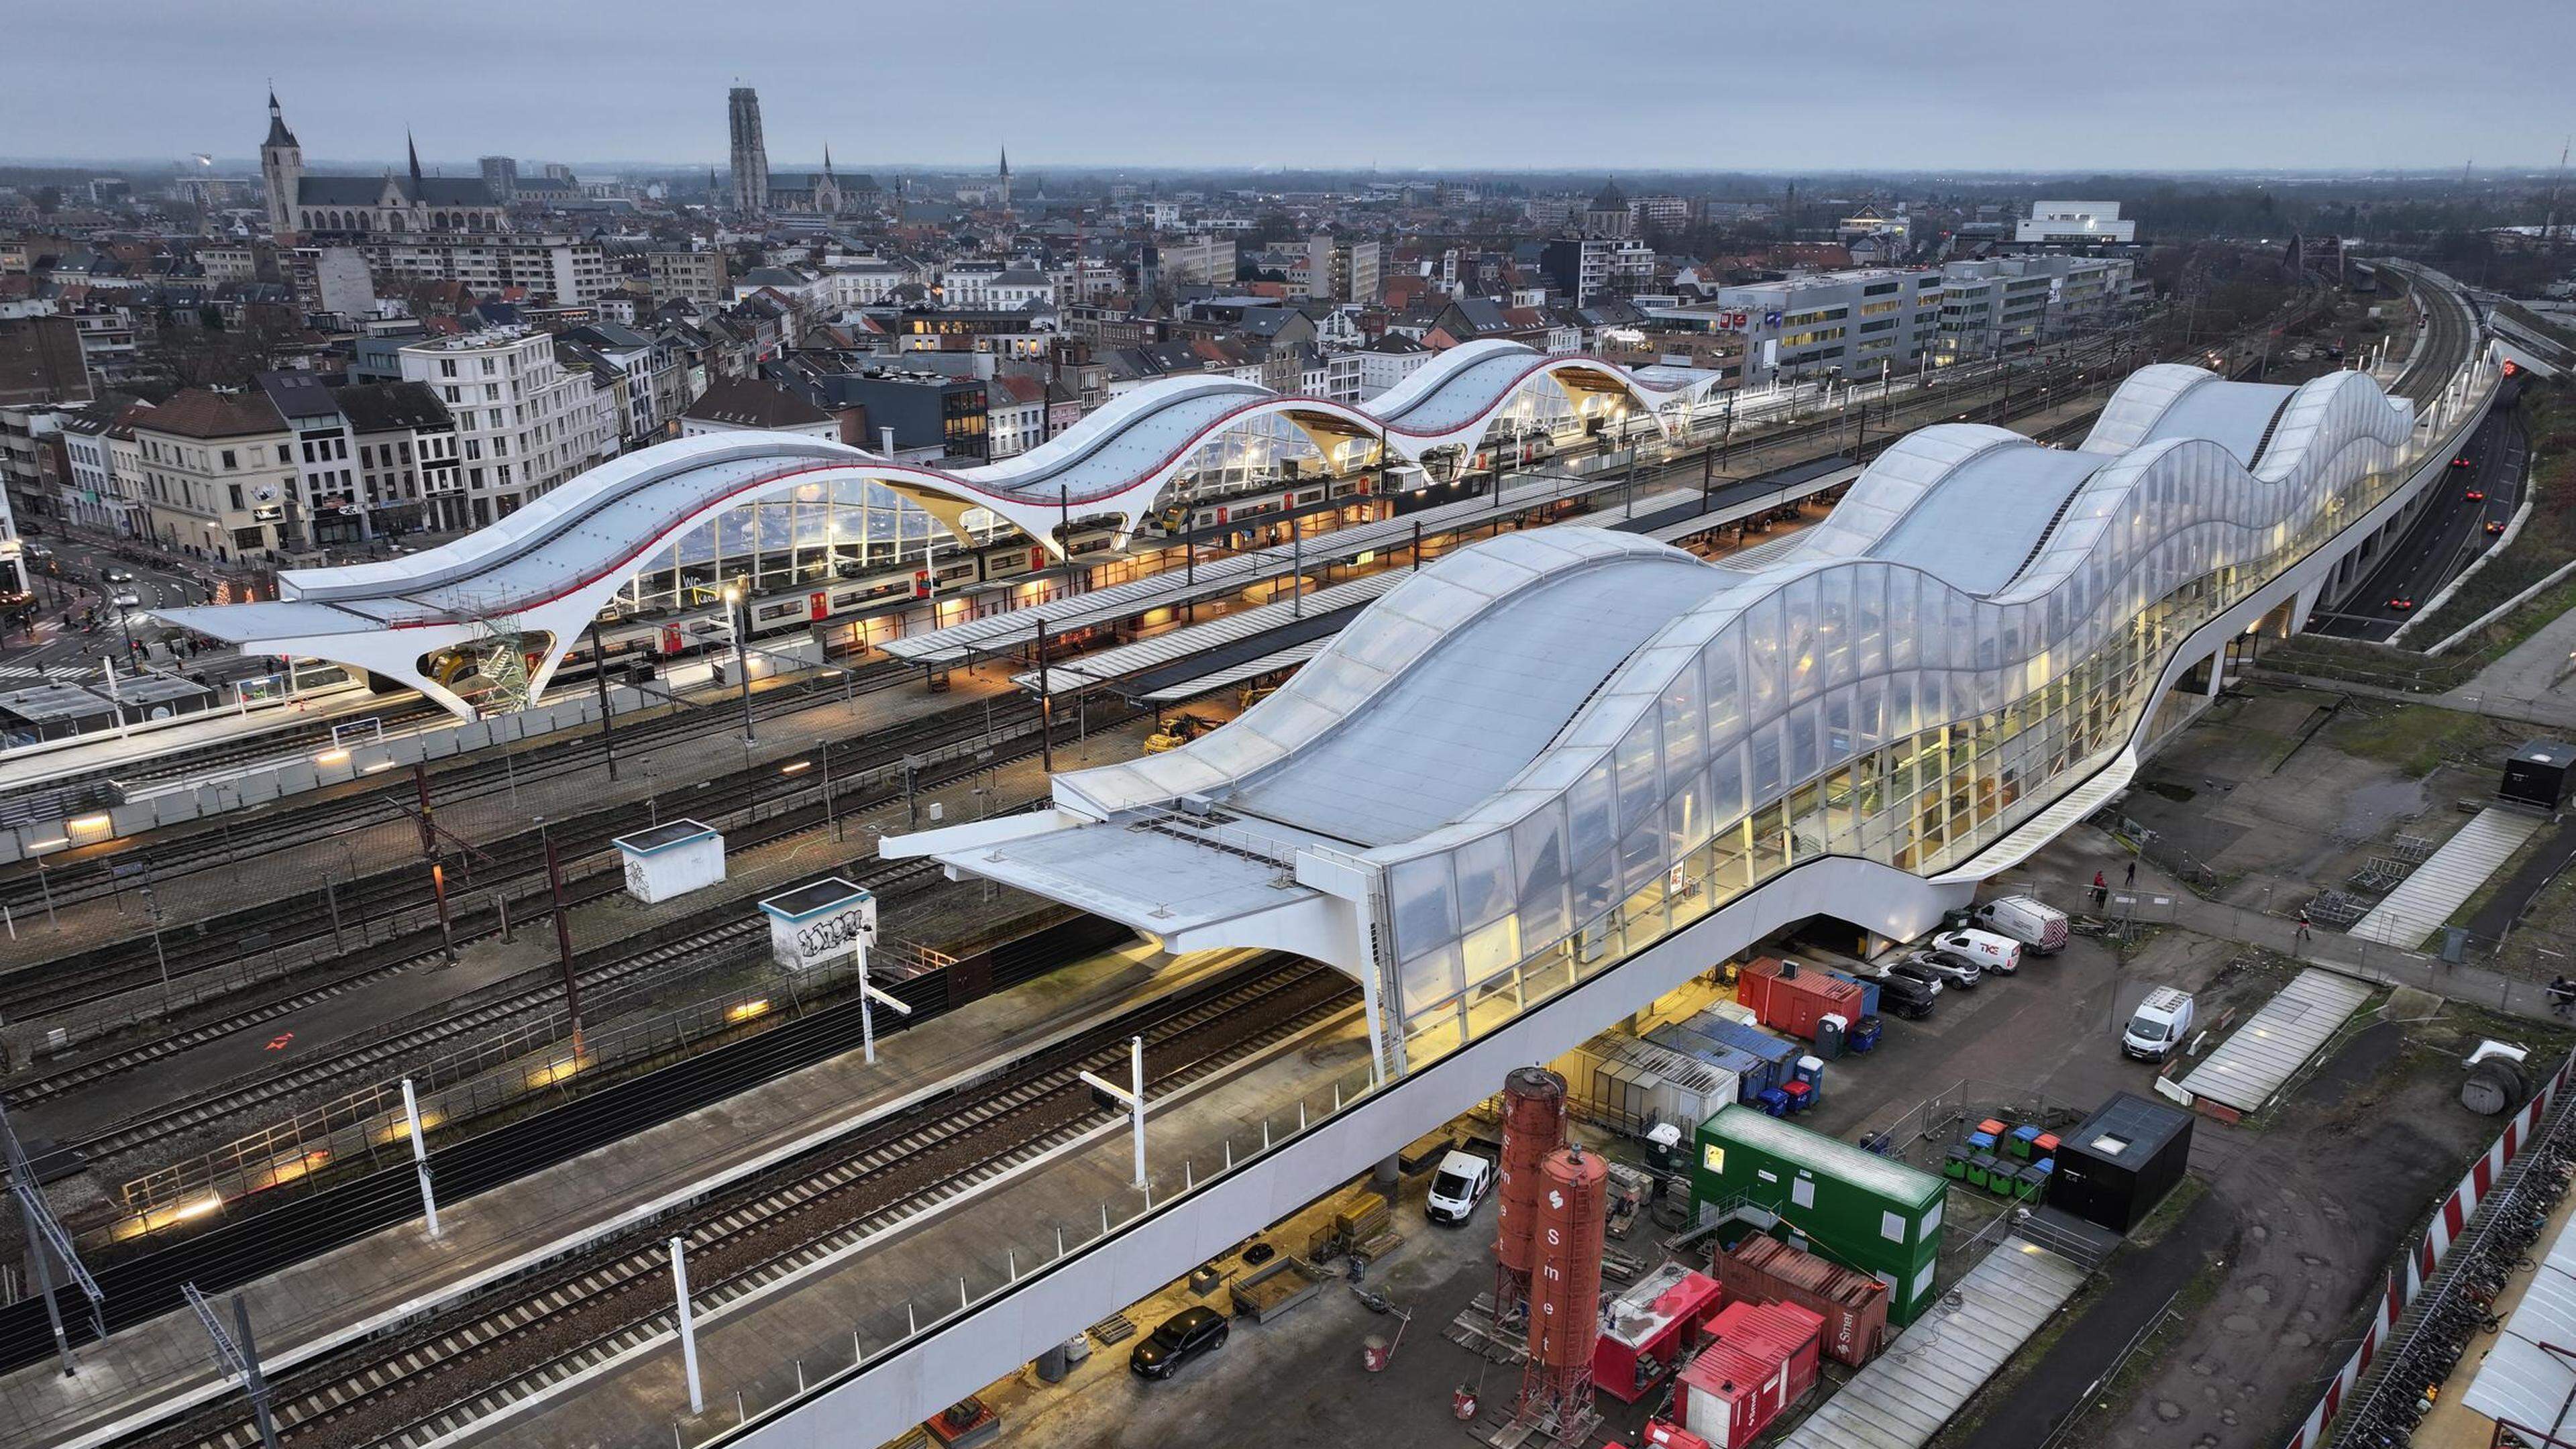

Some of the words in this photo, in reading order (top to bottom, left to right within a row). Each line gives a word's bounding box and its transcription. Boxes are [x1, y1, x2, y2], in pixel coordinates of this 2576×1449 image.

[682, 574, 700, 586] WC
[1980, 943, 1999, 955] TKE
[1544, 1228, 1559, 1351] Smet
[1840, 1312, 1854, 1343] Smet
